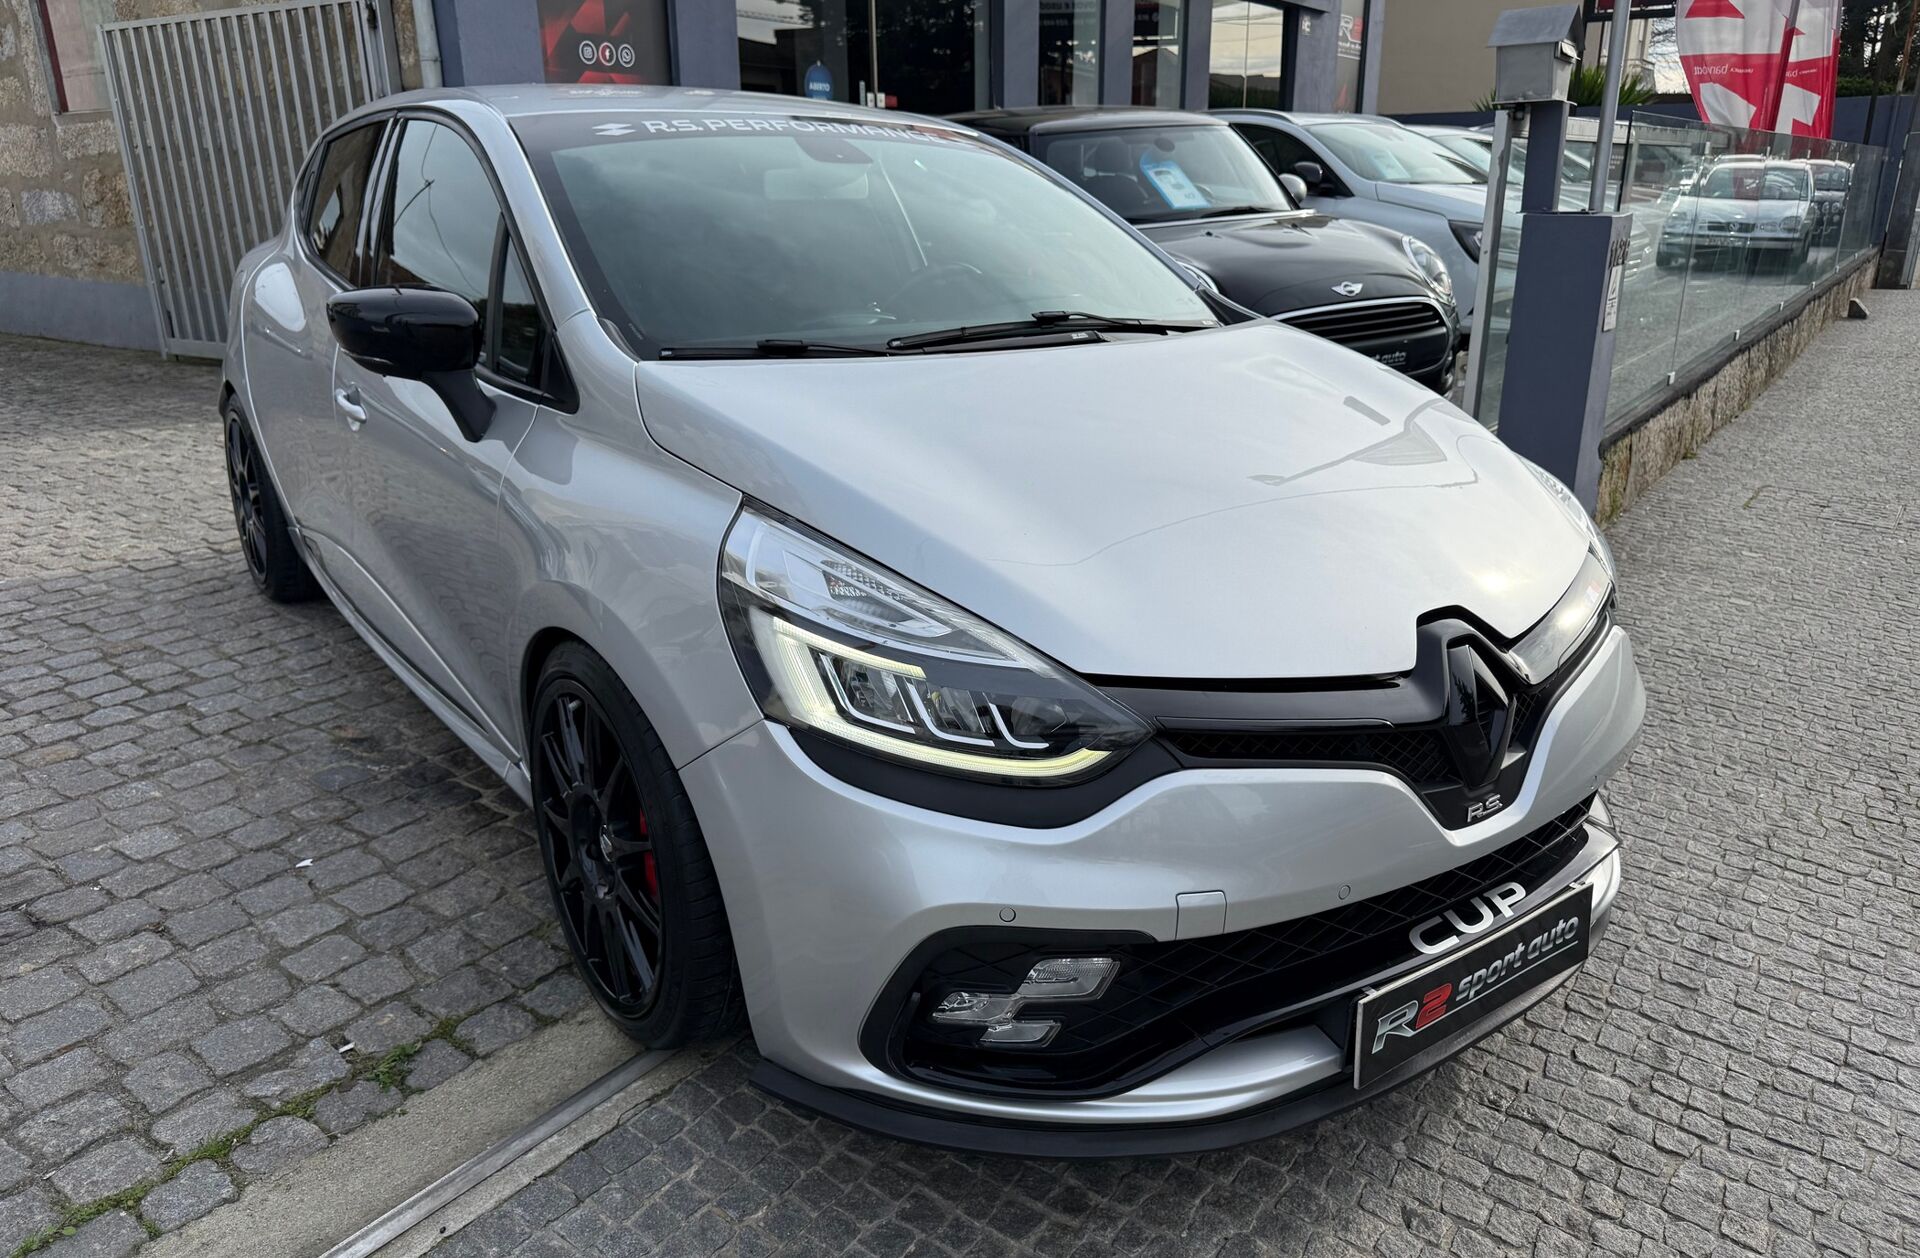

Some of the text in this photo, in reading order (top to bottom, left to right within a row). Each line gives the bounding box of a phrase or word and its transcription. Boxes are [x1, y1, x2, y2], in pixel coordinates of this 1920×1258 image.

[1409, 882, 1526, 954] CUP
[1372, 916, 1579, 1054] R2 sport auto
